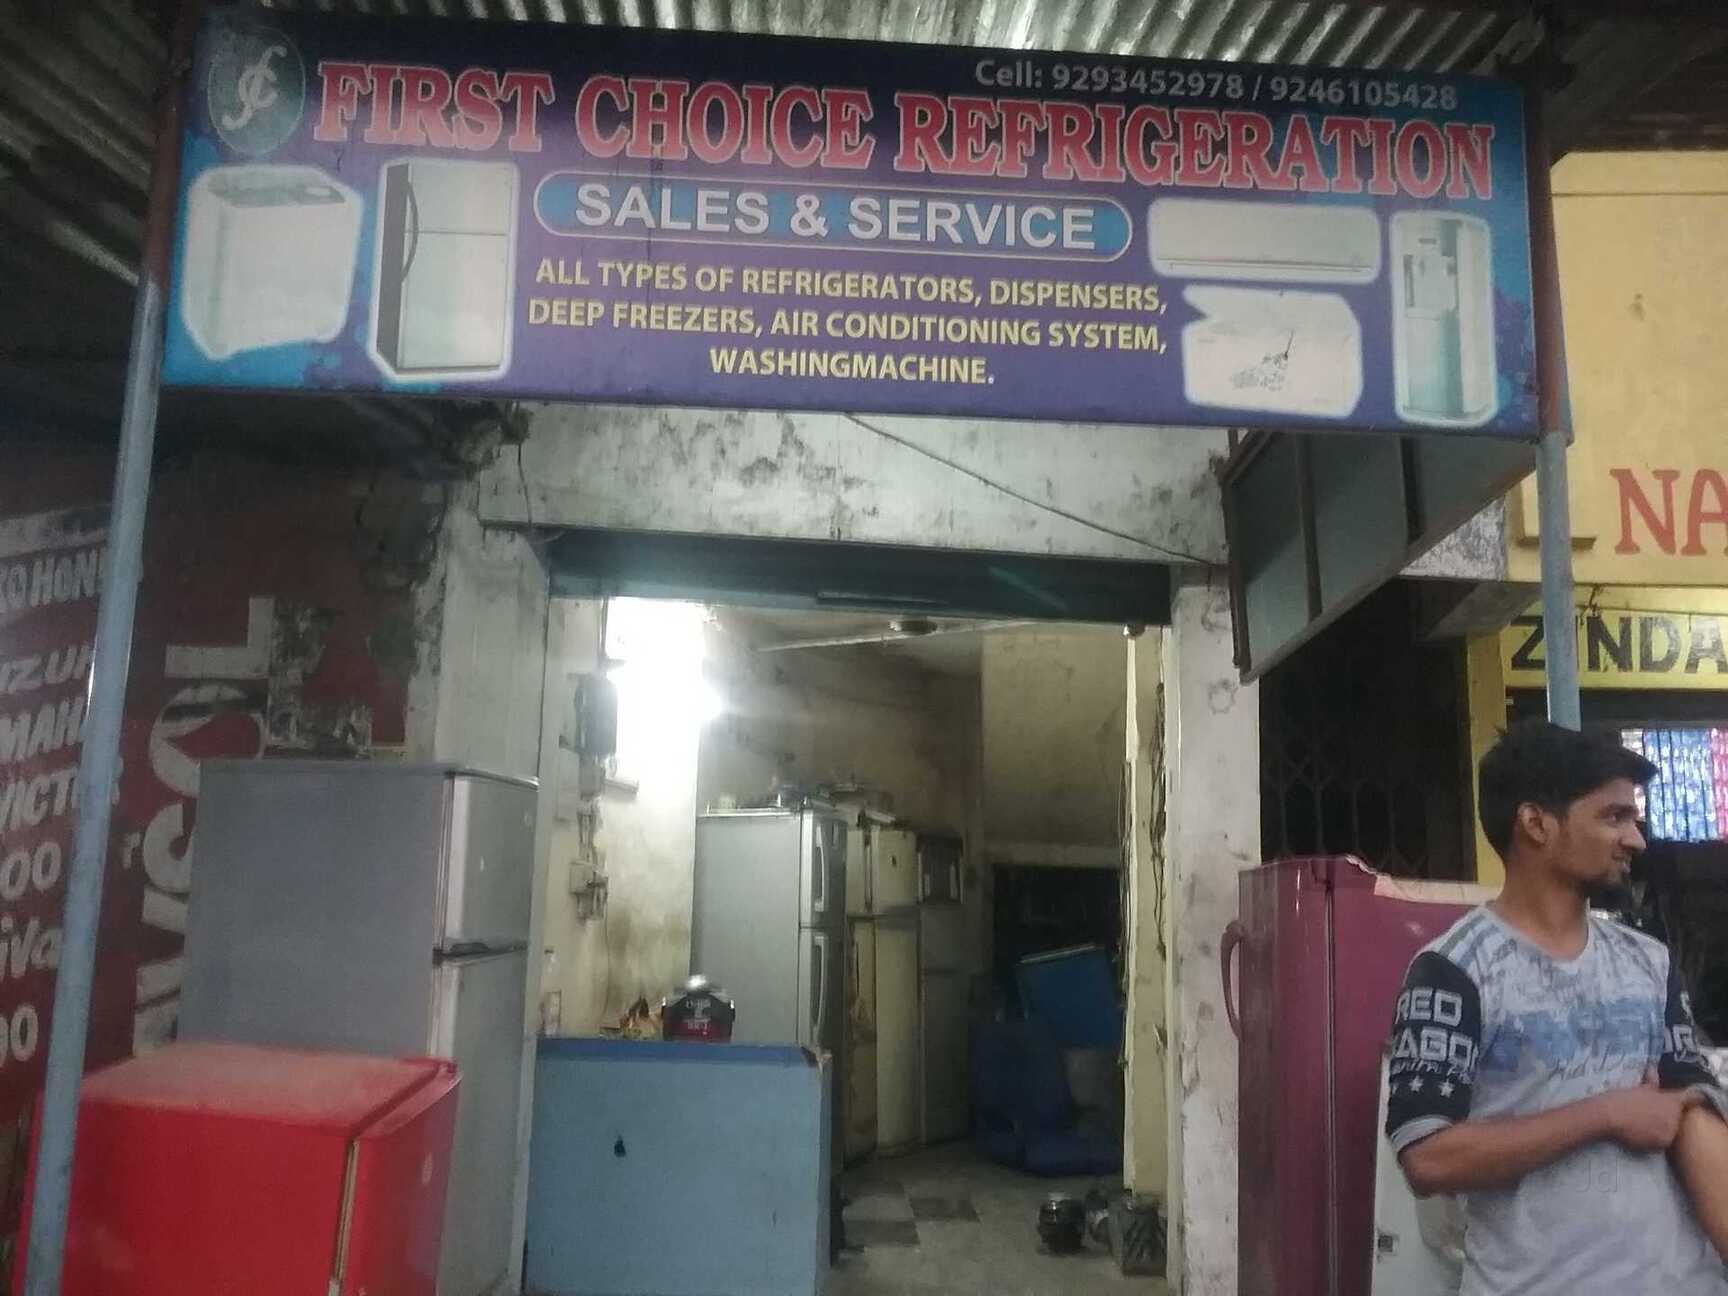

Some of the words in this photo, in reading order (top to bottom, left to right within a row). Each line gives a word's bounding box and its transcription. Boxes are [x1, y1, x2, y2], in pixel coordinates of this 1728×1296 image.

[975, 59, 1043, 89] Cell:
[1053, 63, 1244, 100] 9293452978
[1270, 71, 1459, 111] 9246105428
[312, 60, 555, 152] FIRST
[575, 75, 877, 170] CHOICE
[893, 90, 1496, 200] REFRIGERATION
[575, 183, 770, 235] SALES
[790, 194, 829, 238] &
[848, 197, 1096, 250] SERVICE
[535, 257, 590, 286] ALL
[597, 261, 688, 291] TYPES
[694, 266, 735, 293] OF
[741, 268, 983, 308] REFRIGERATORS,
[989, 279, 1168, 315] DISPENSERS,
[528, 298, 605, 328] DEEP
[612, 302, 764, 338] FREEZERS,
[769, 307, 819, 338] AIR
[825, 311, 1041, 347] CONDITIONING
[1047, 321, 1168, 355] SYSTEM,
[708, 348, 996, 385] WASHINGMACHINE.
